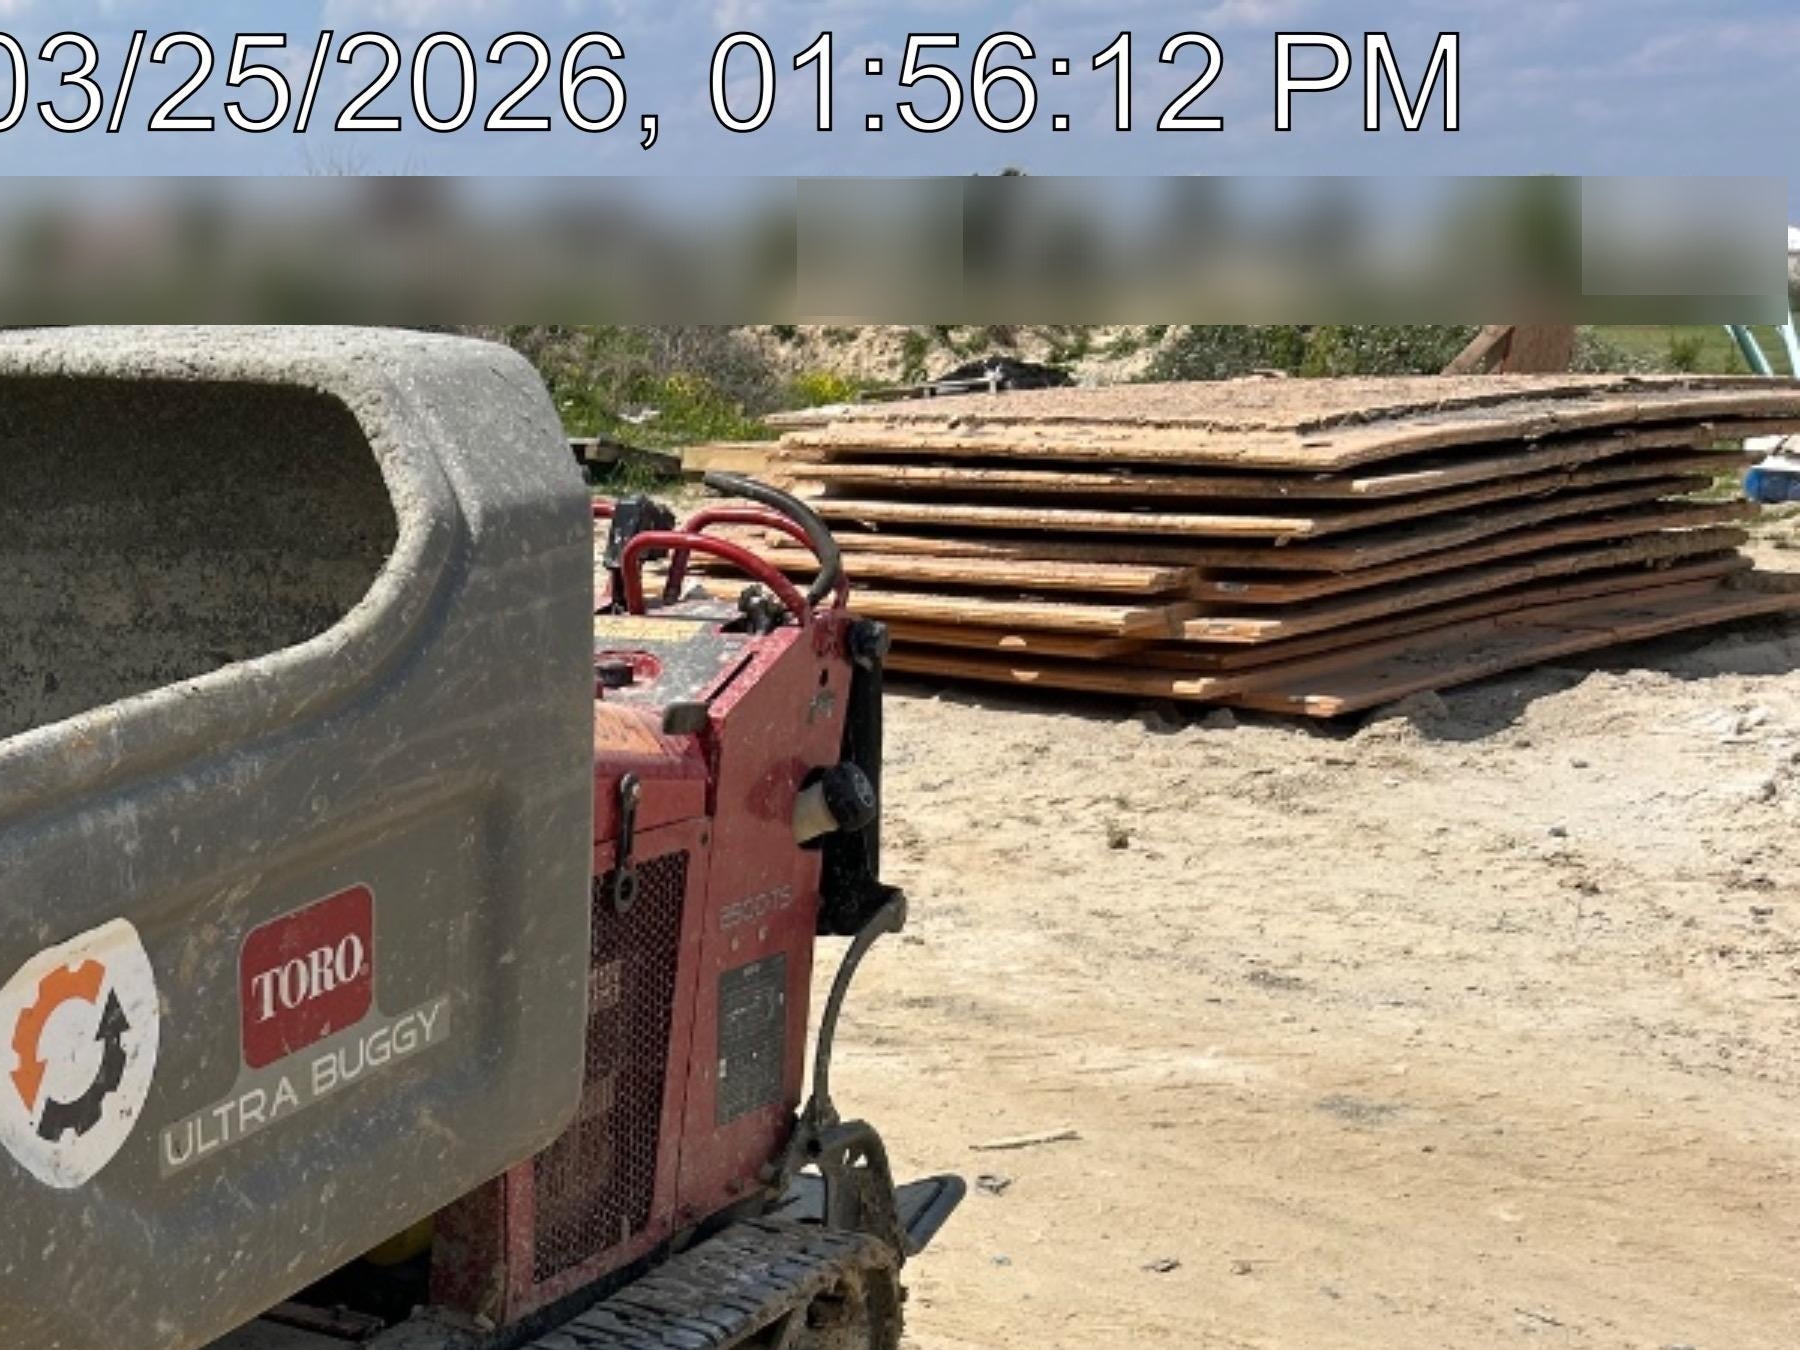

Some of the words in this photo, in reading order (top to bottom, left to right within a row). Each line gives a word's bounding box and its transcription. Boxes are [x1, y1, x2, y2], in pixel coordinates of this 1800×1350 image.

[251, 934, 365, 1023] TORO
[163, 1076, 298, 1167] ULTRA
[311, 1006, 442, 1096] BUGGY
